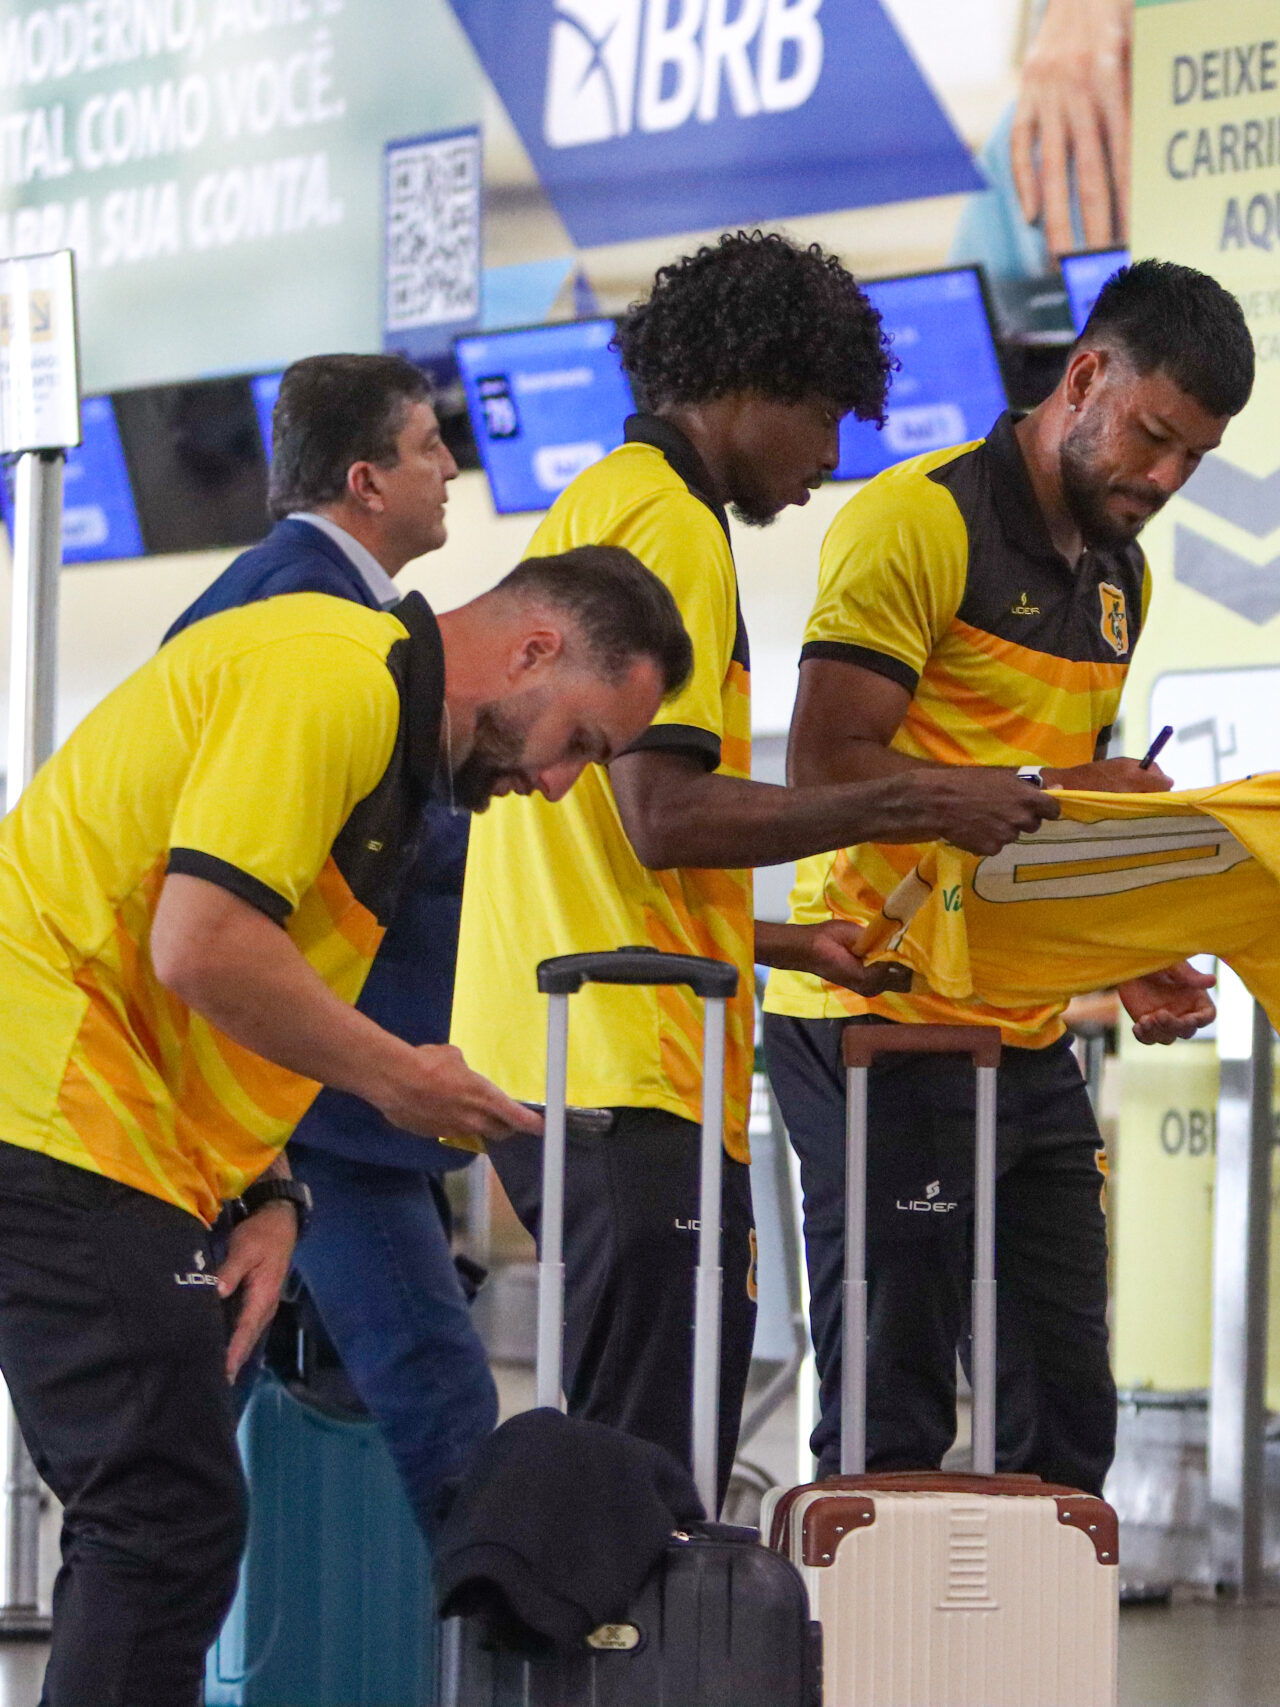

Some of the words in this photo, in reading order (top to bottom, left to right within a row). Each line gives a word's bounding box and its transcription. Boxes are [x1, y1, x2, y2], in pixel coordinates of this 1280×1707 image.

[636, 0, 825, 134] BRB
[1172, 40, 1279, 106] DEIXE
[76, 72, 210, 172] COMO
[99, 181, 181, 267] SUA
